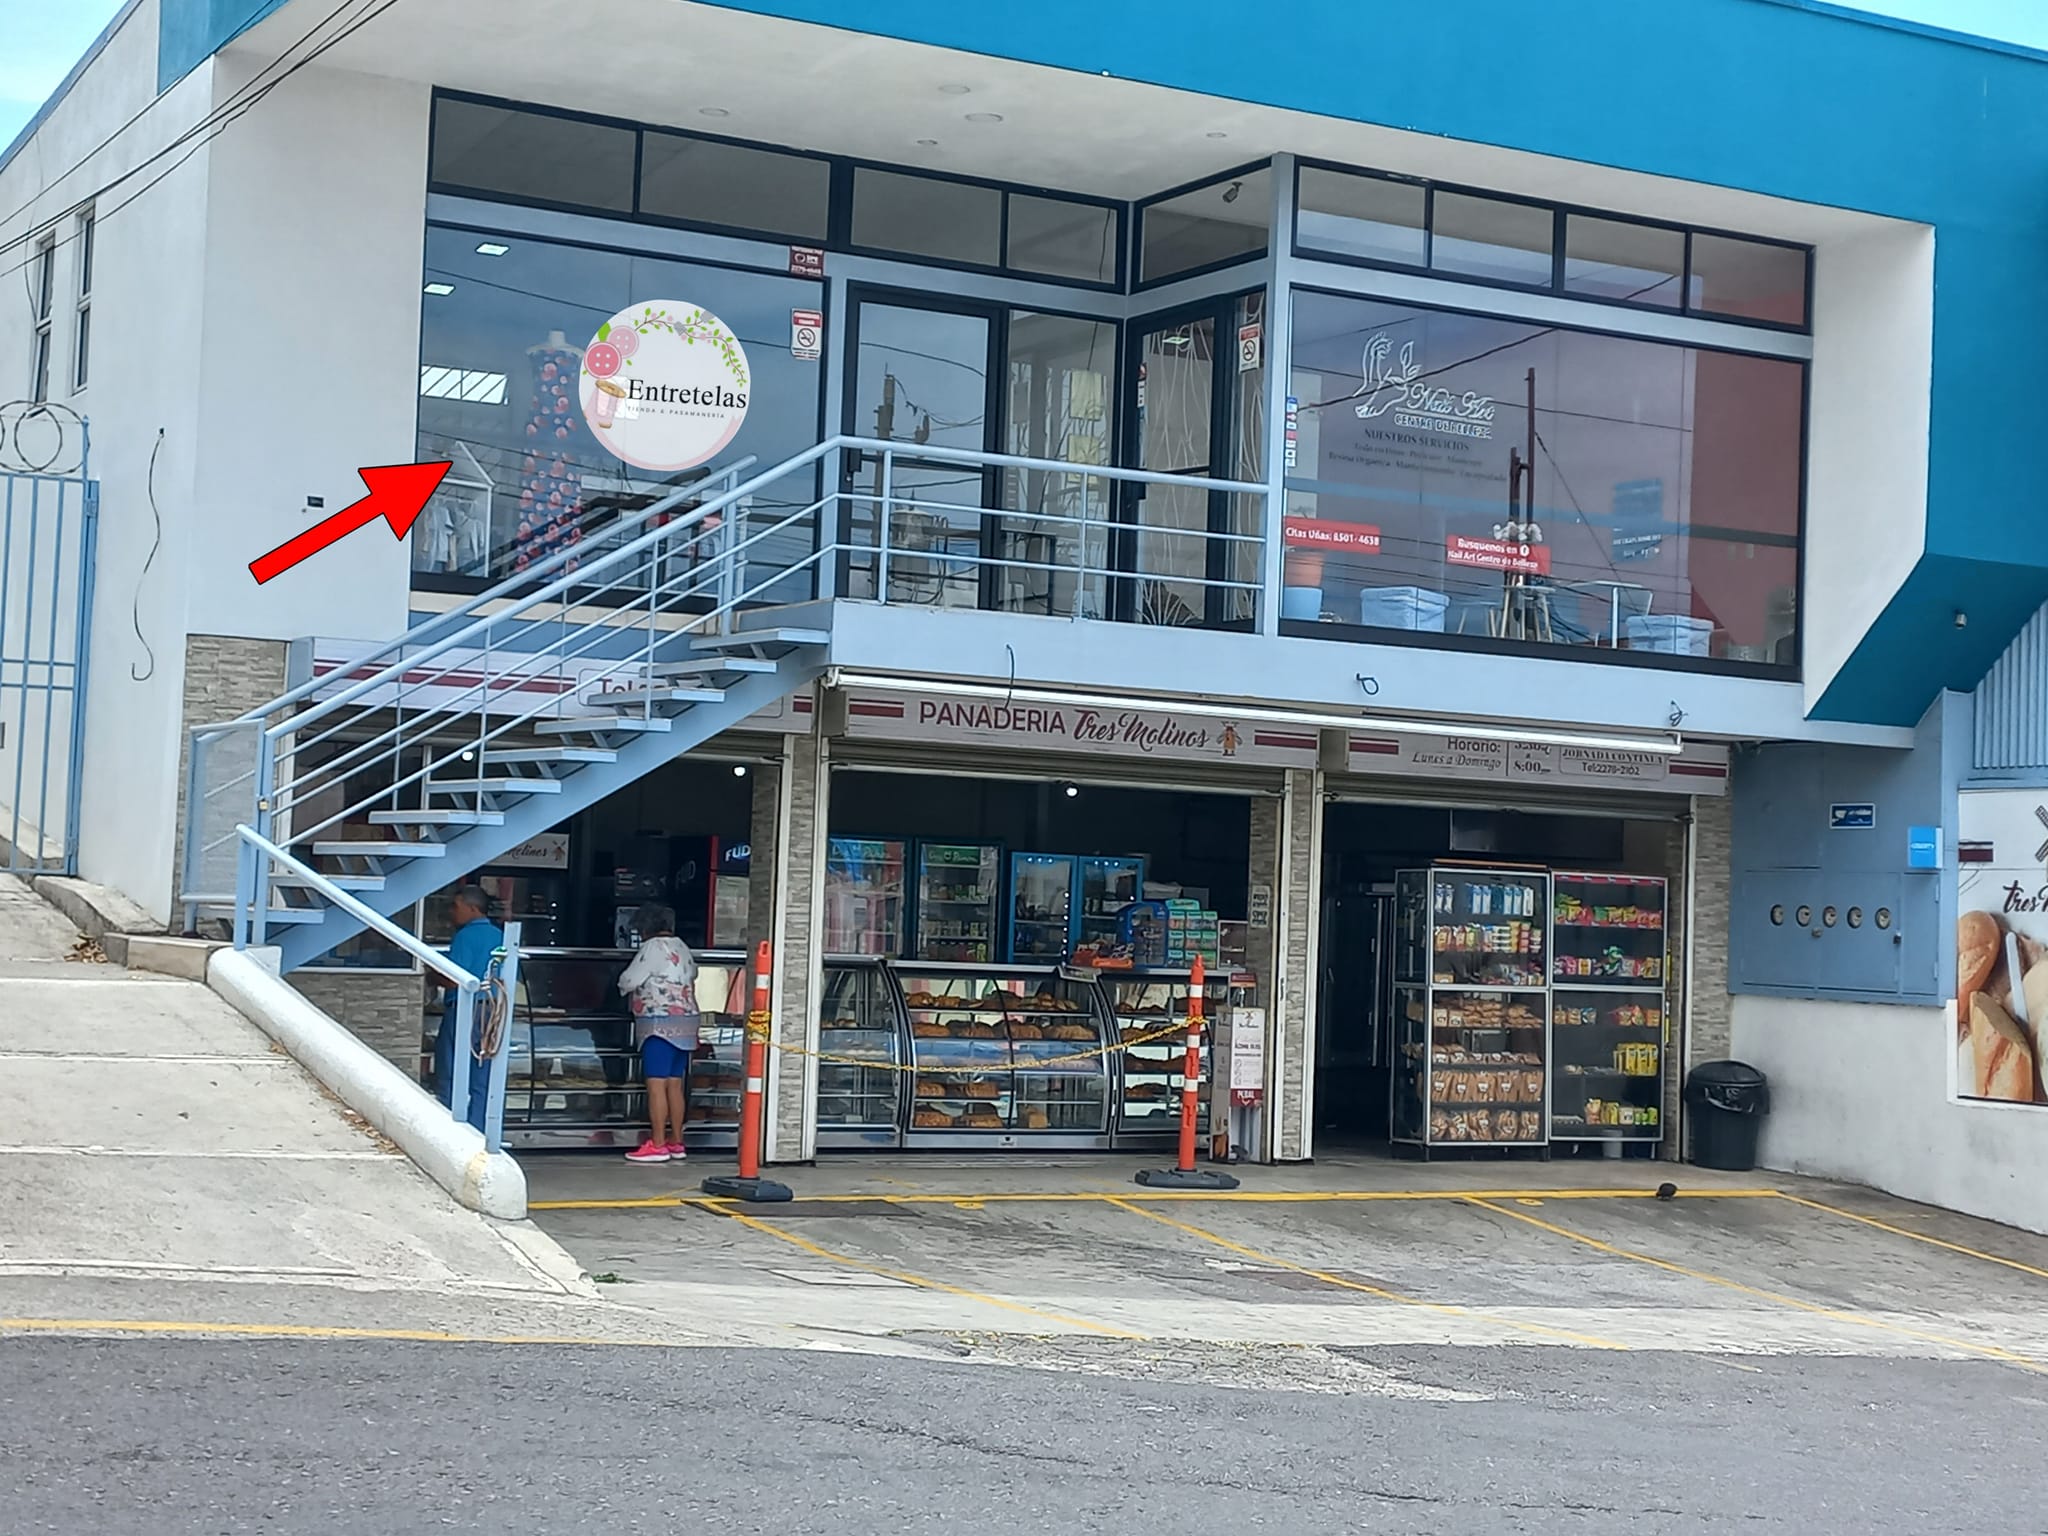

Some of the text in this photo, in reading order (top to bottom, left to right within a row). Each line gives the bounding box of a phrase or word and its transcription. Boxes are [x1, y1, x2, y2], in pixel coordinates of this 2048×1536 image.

[628, 379, 747, 409] Entretelas
[627, 405, 656, 413] TIENDA
[1364, 428, 1418, 446] NUESTROS
[1418, 436, 1470, 451] SERVICIOS
[1285, 527, 1307, 539] Citas
[1506, 545, 1518, 554] en
[1476, 553, 1500, 564] Centro
[919, 701, 1209, 752] PANADERIA Tres Molinos
[1447, 736, 1501, 753] Horario:
[1412, 752, 1444, 763] Lunes
[1455, 754, 1502, 771] Domingo
[725, 845, 751, 862] FUD
